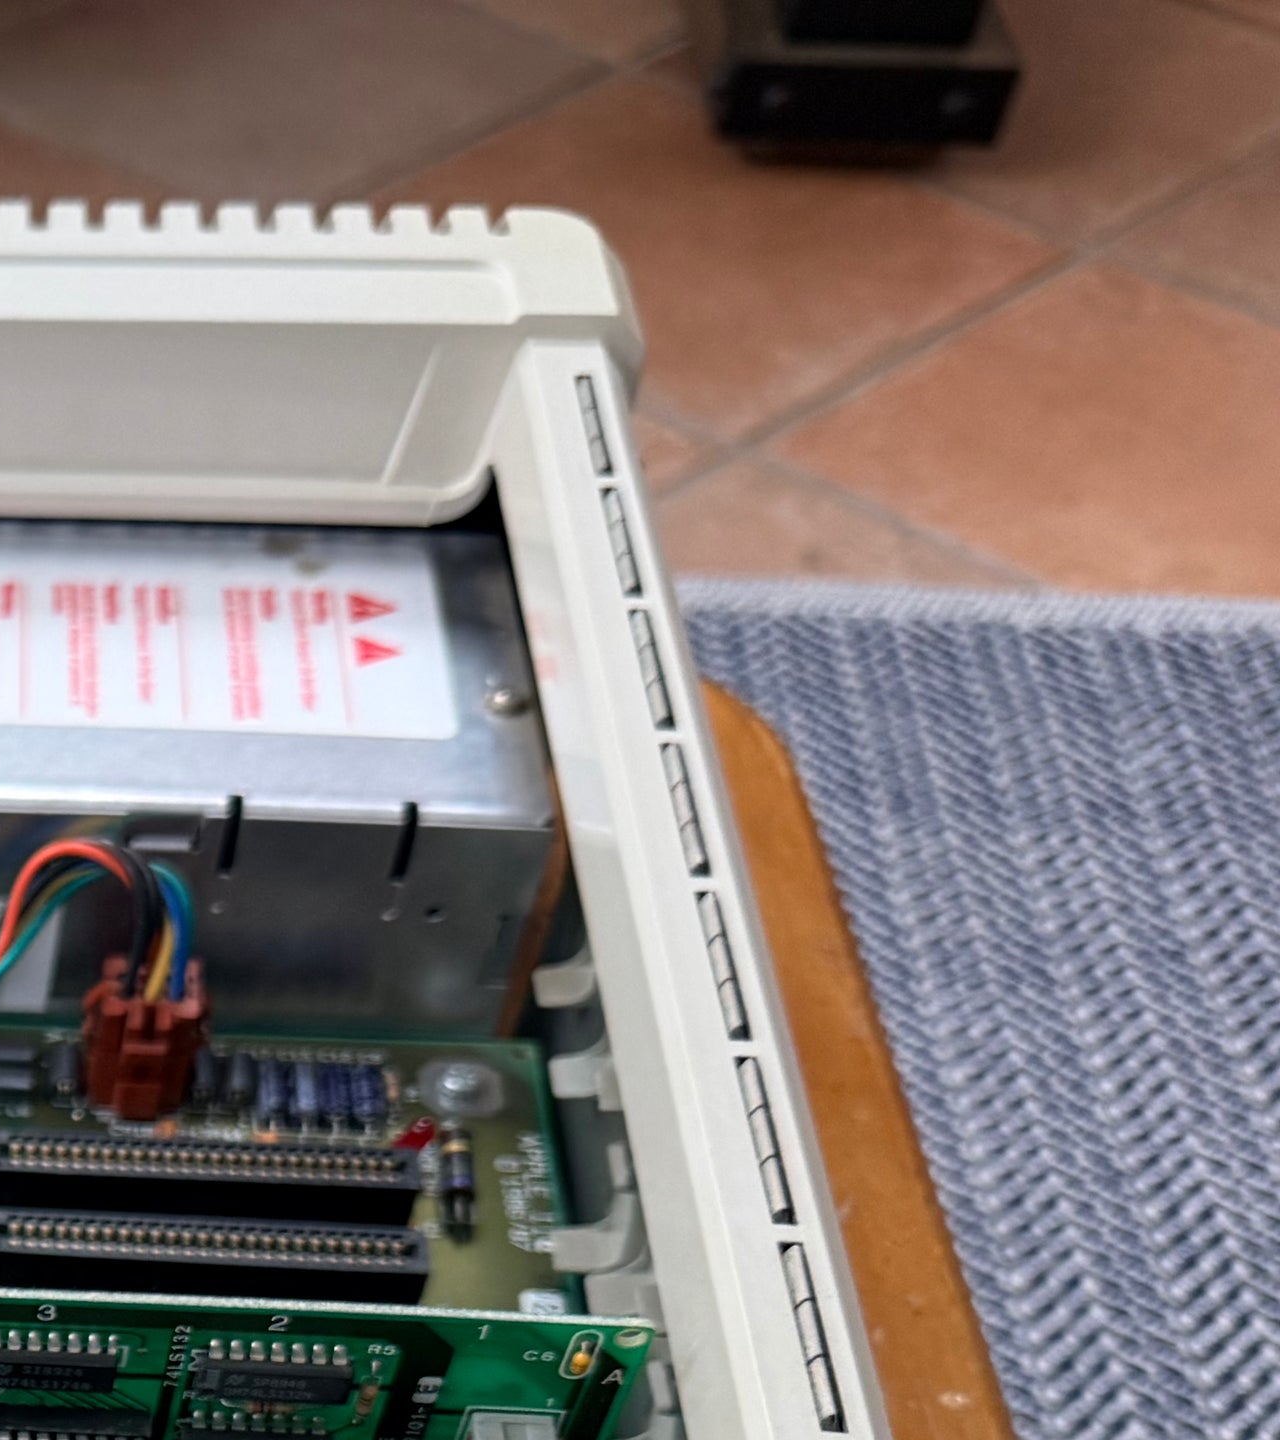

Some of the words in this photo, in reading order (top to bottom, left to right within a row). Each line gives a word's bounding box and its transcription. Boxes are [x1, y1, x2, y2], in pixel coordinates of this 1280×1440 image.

[36, 1303, 58, 1322] 3
[267, 1314, 291, 1333] 2
[477, 1323, 490, 1341] 1
[163, 1324, 192, 1388] 74LS132
[367, 1343, 397, 1356] R5
[600, 1368, 625, 1386] A
